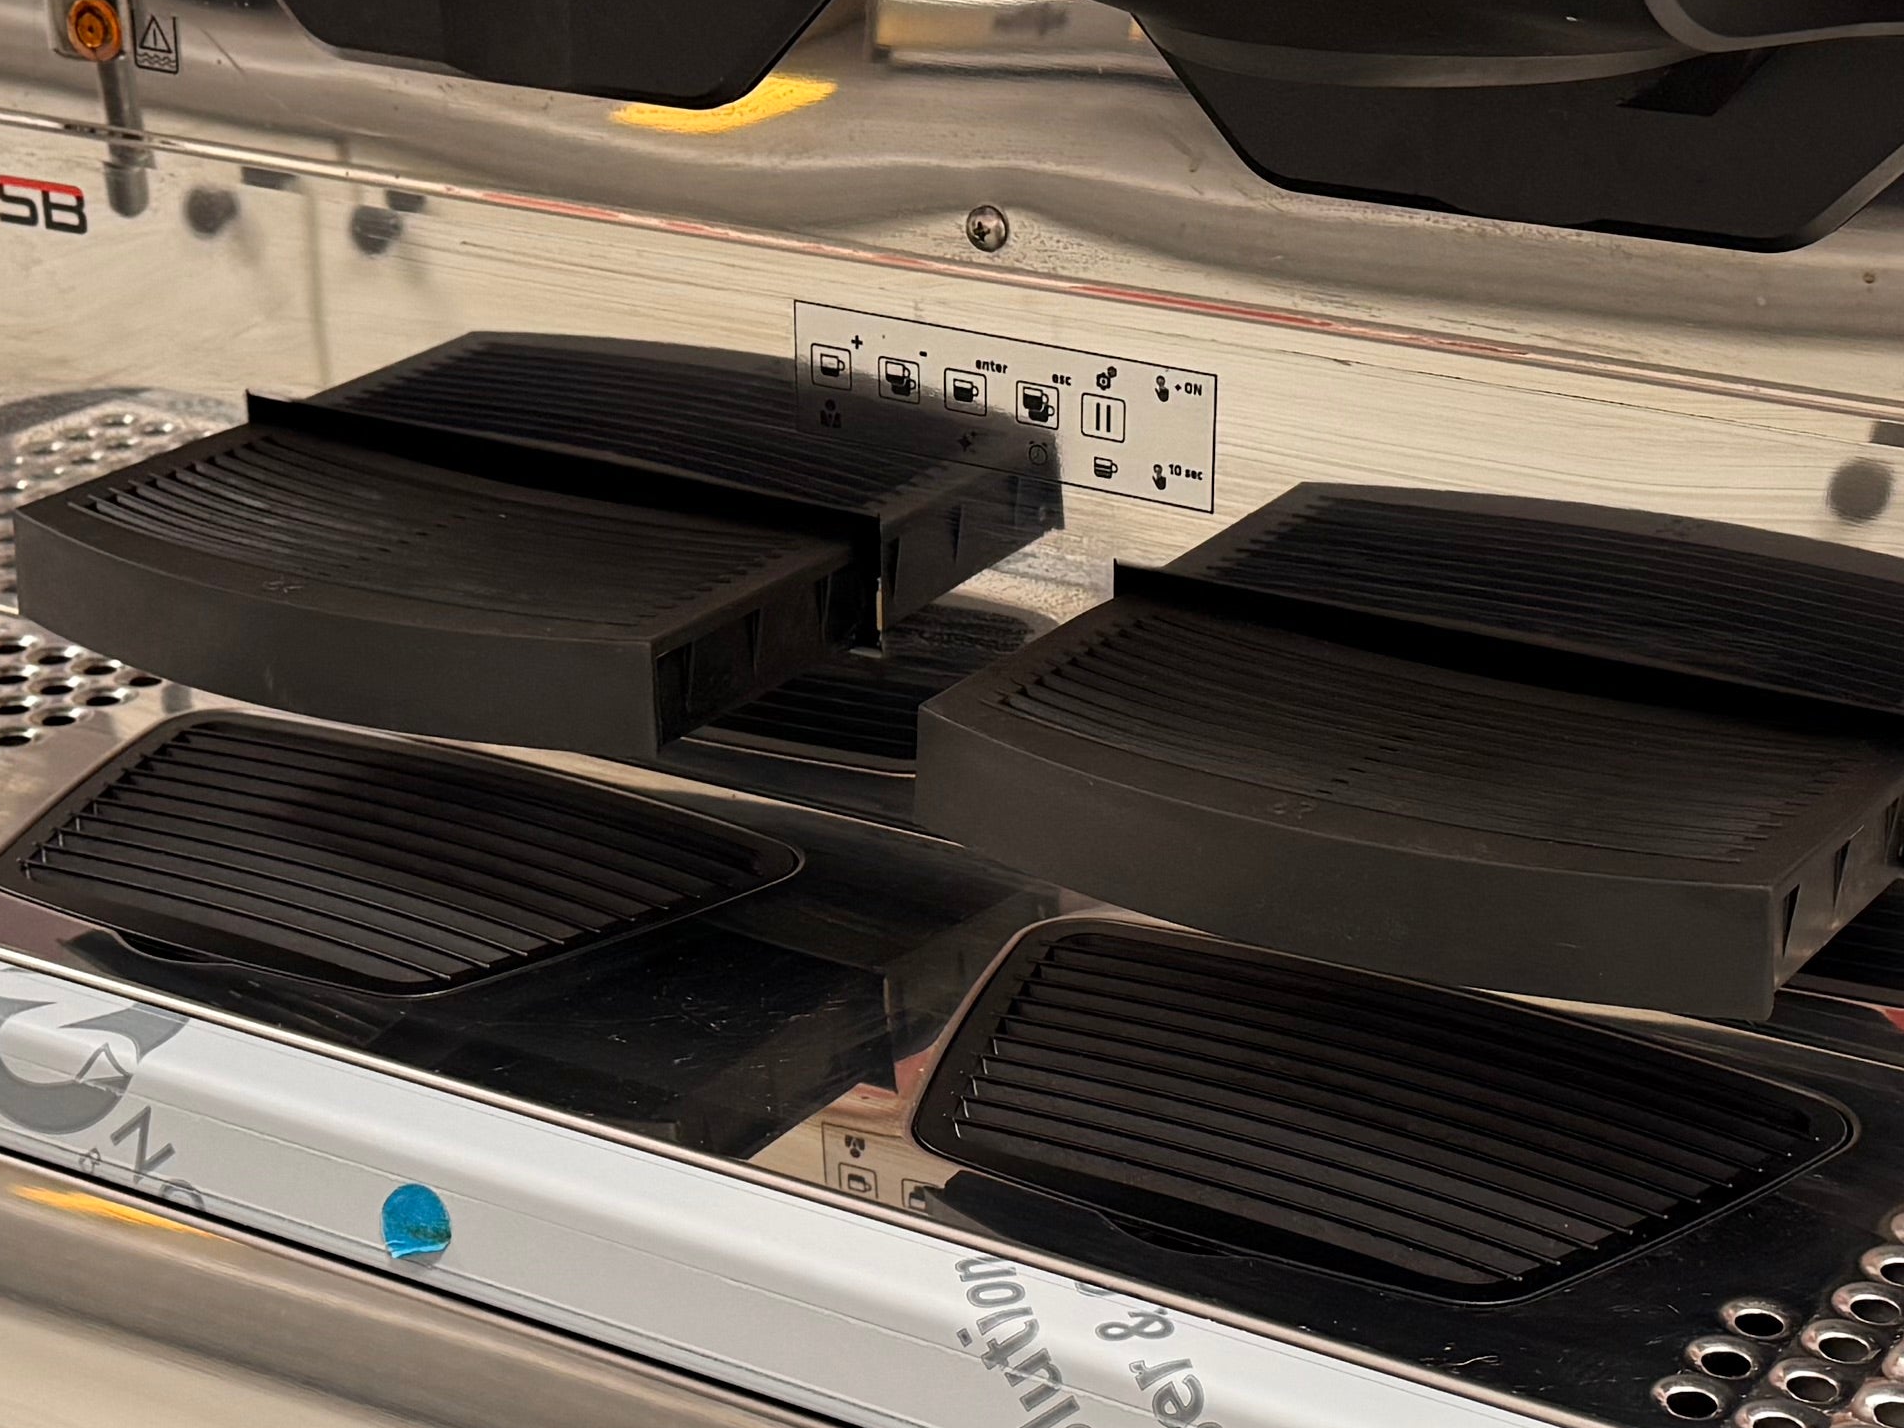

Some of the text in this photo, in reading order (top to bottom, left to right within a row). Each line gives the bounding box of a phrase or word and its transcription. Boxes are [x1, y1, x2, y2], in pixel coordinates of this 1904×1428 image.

[975, 358, 1008, 375] enter
[1052, 373, 1072, 388] esc
[1184, 382, 1203, 397] ON
[1168, 462, 1204, 482] 10 sec
